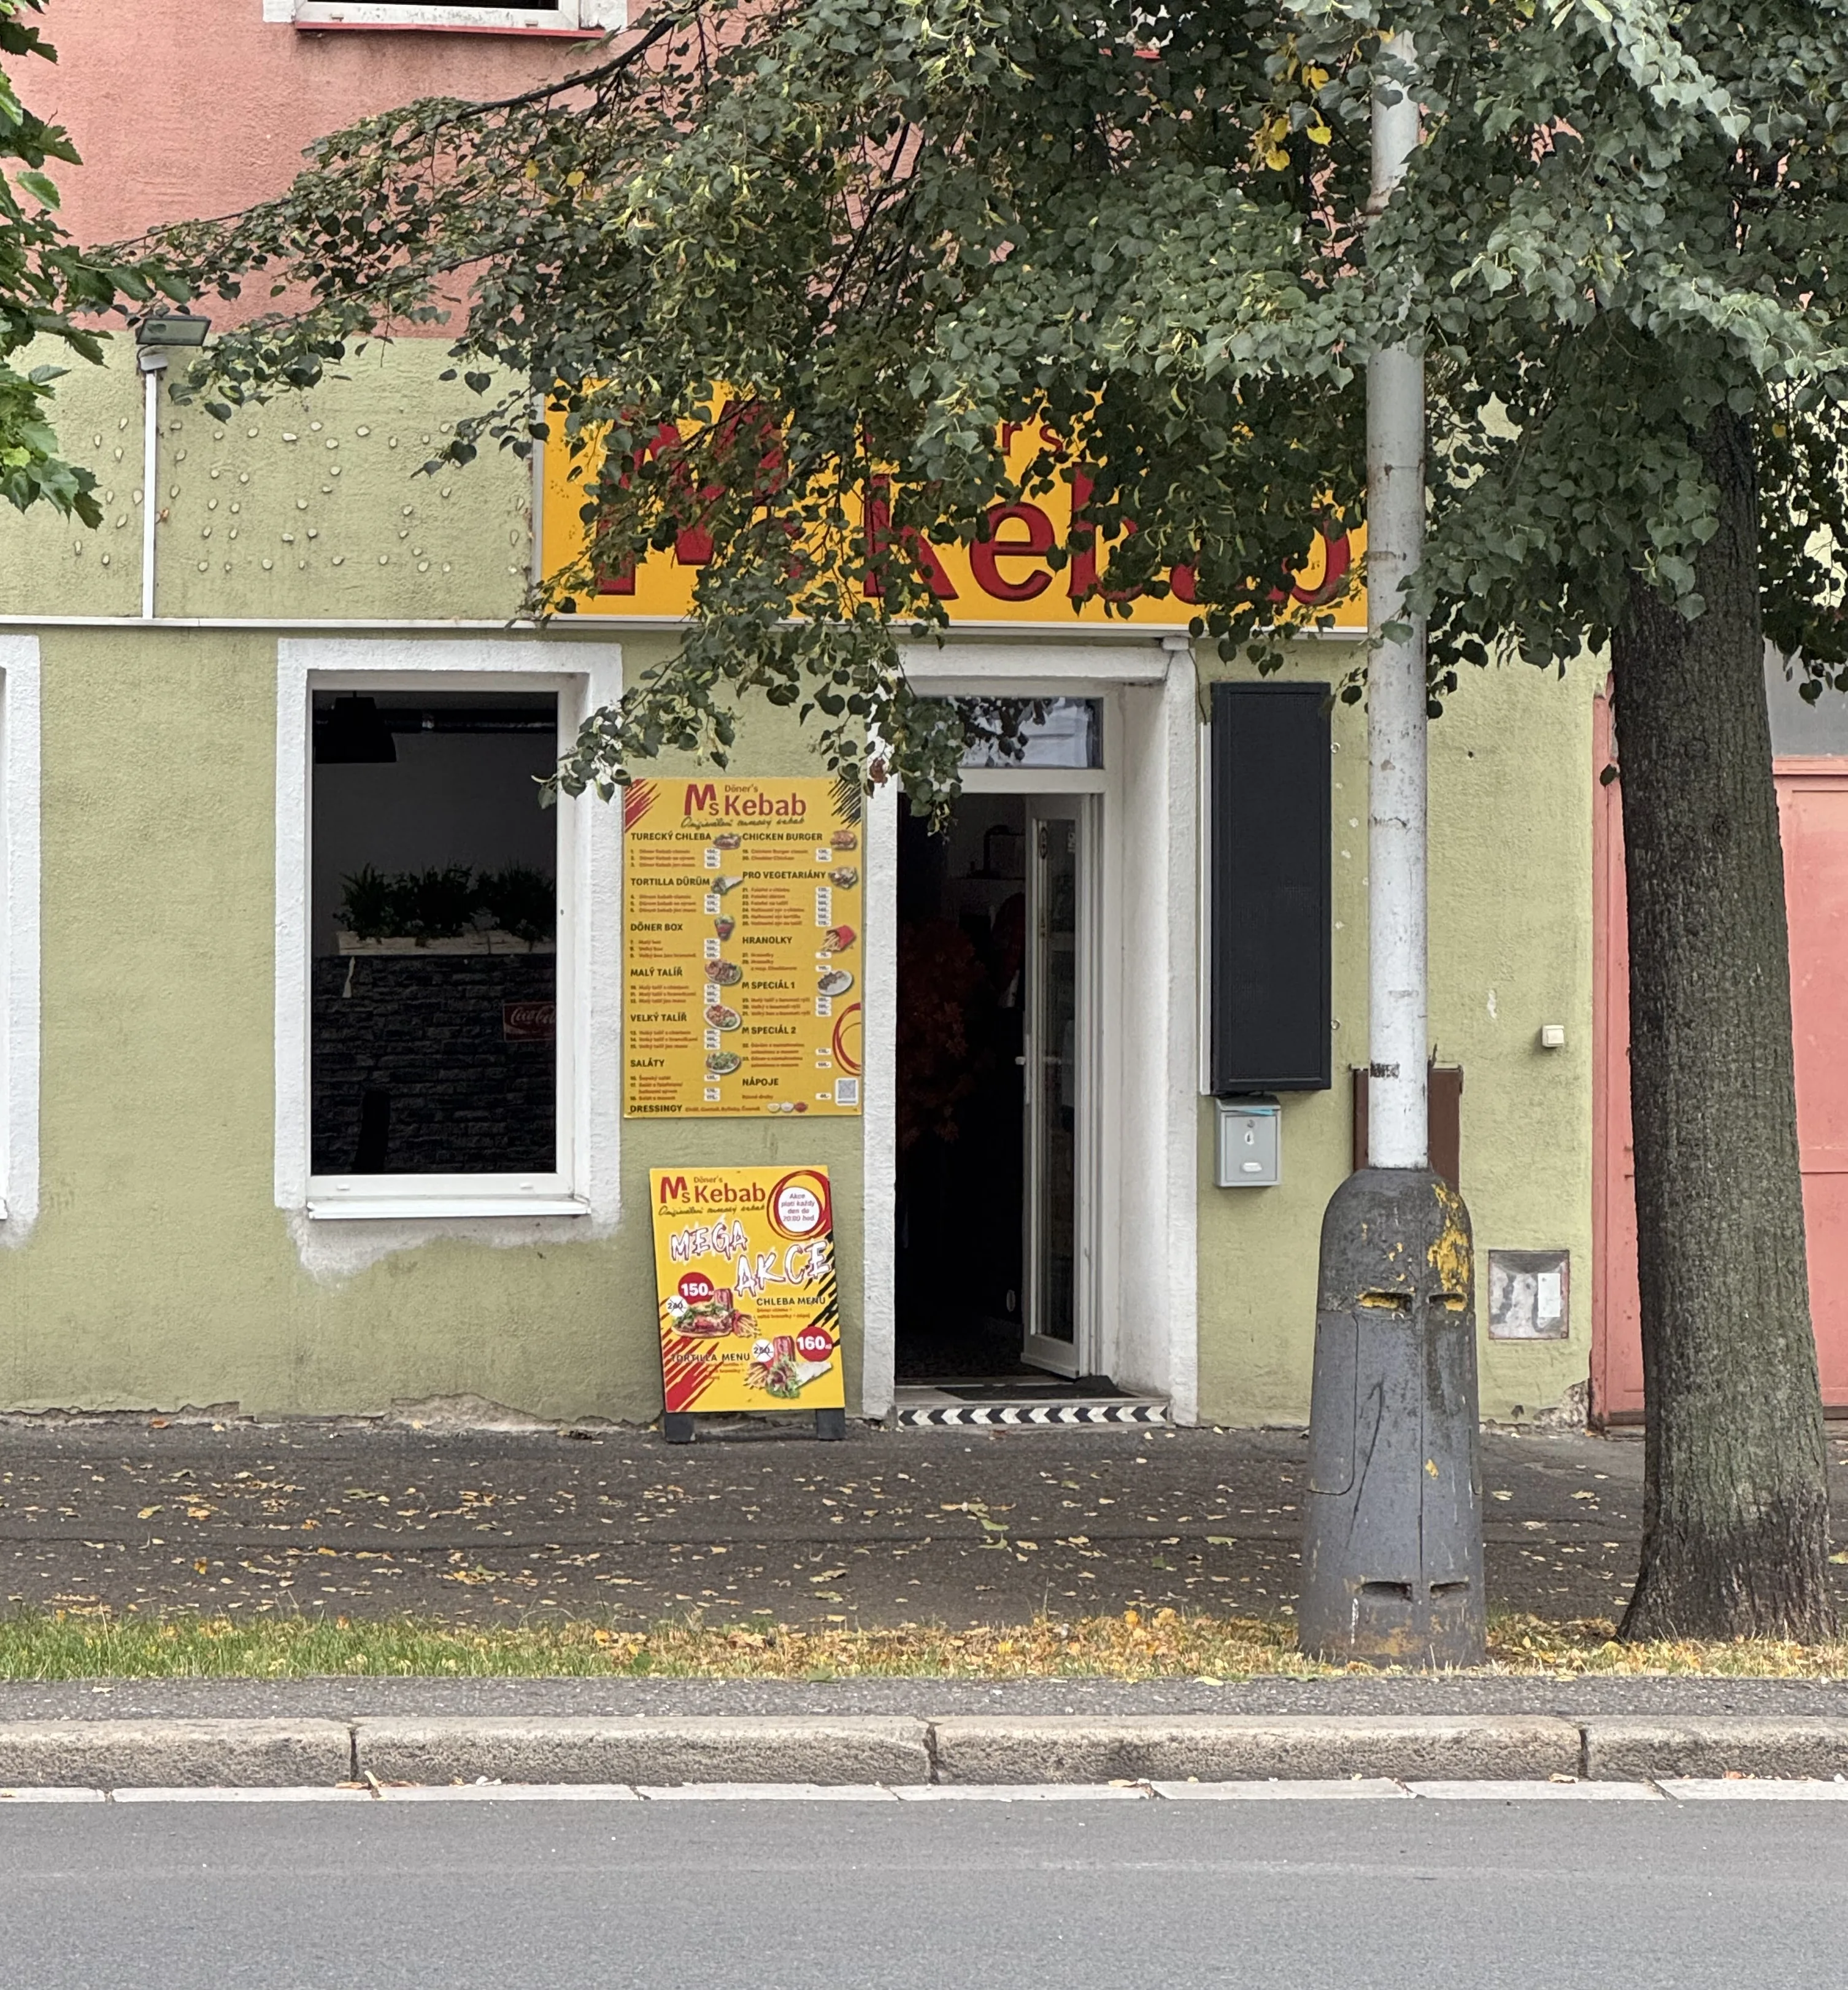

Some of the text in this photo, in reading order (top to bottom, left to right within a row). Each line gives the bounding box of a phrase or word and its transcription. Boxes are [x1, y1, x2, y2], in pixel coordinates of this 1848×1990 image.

[725, 784, 759, 793] Döner's
[725, 792, 807, 816] Kebab
[631, 830, 673, 841] TURECKÝ
[763, 869, 826, 879] VEGETARIÁNY
[676, 876, 710, 885] DÜRÜM
[630, 922, 662, 931] DÖNER
[631, 966, 683, 976] MALÝ TALÍŘ
[752, 979, 789, 989] SPECIÁL
[630, 1012, 687, 1022] VELKÝ TALÍŘ
[752, 1025, 789, 1034] SPECIÁL
[630, 1057, 664, 1067] SALÁTY
[742, 1076, 779, 1086] NÁPOJE
[693, 1175, 723, 1184] Döner's
[695, 1182, 766, 1203] Kebab
[671, 1219, 749, 1261] MEGA
[736, 1240, 831, 1297] AKCE
[756, 1297, 826, 1306] CHLEBA MENU
[671, 1353, 717, 1362] TORTILLA
